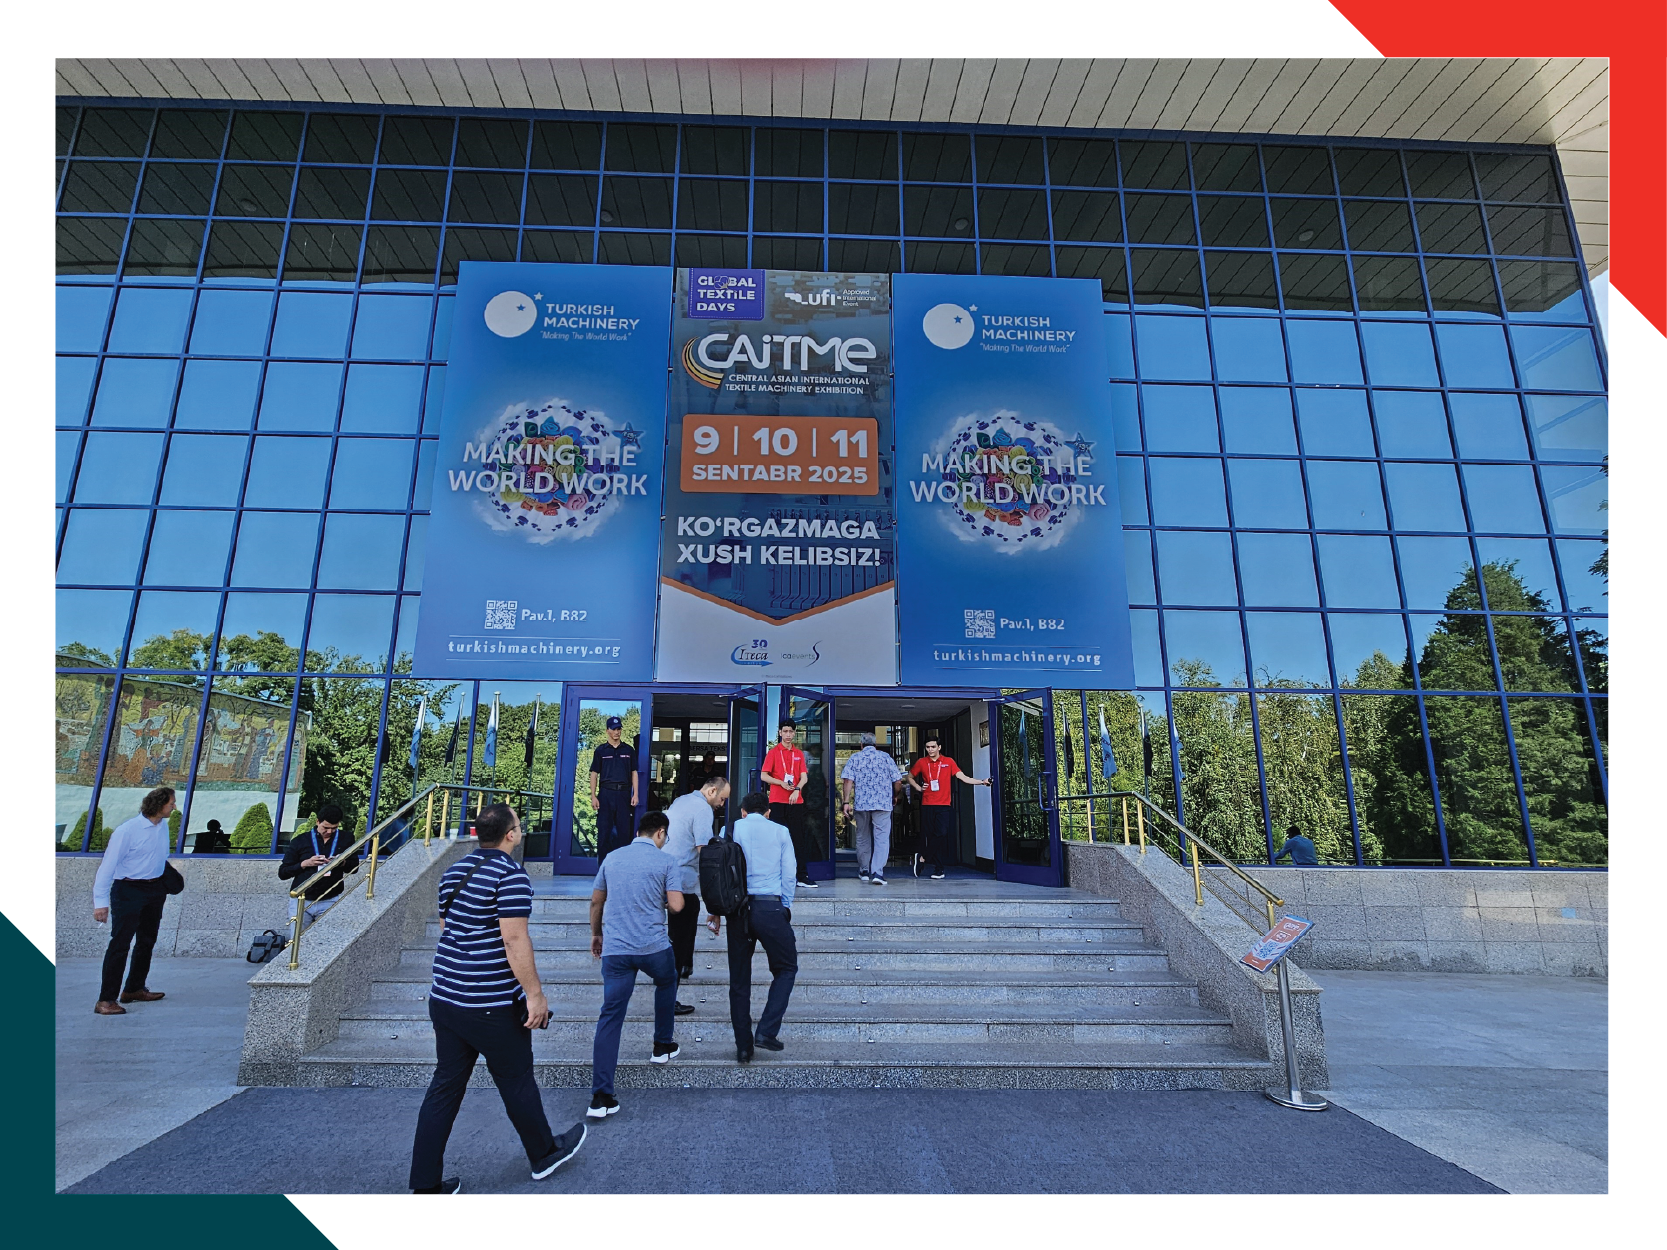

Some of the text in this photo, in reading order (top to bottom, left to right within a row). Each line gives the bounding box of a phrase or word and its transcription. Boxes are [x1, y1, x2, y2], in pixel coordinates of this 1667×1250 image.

[546, 303, 614, 315] TURKISH
[696, 302, 736, 312] DAYS
[543, 316, 640, 330] MACHINERY
[982, 315, 1050, 327] TURKISH
[572, 331, 584, 340] The
[586, 332, 607, 341] World
[982, 328, 1076, 342] MACHINERY
[1011, 343, 1024, 352] The
[1025, 344, 1047, 353] World
[728, 374, 870, 385] CENTRAL ASIAN INTERNATIONAL
[725, 384, 865, 395] TEXTILE MACHINERY EXHIBITION
[693, 425, 720, 455] 9
[752, 427, 798, 456] 10
[830, 429, 868, 458] 11
[463, 442, 637, 466] MAKING THE
[922, 453, 1092, 476] MAKING THE
[692, 464, 868, 484] SENTABR 2025
[449, 469, 648, 496] WORLD WORK
[909, 480, 1106, 506] WORLD WORK
[676, 543, 880, 567] XUSH KELIBSIZ!
[521, 608, 556, 623] Pav.1,
[1000, 618, 1065, 631] Pav.1, B82
[448, 640, 621, 657] turkishmachinery.org
[751, 639, 768, 649] 30
[933, 649, 1101, 665] turkishmachinery.org
